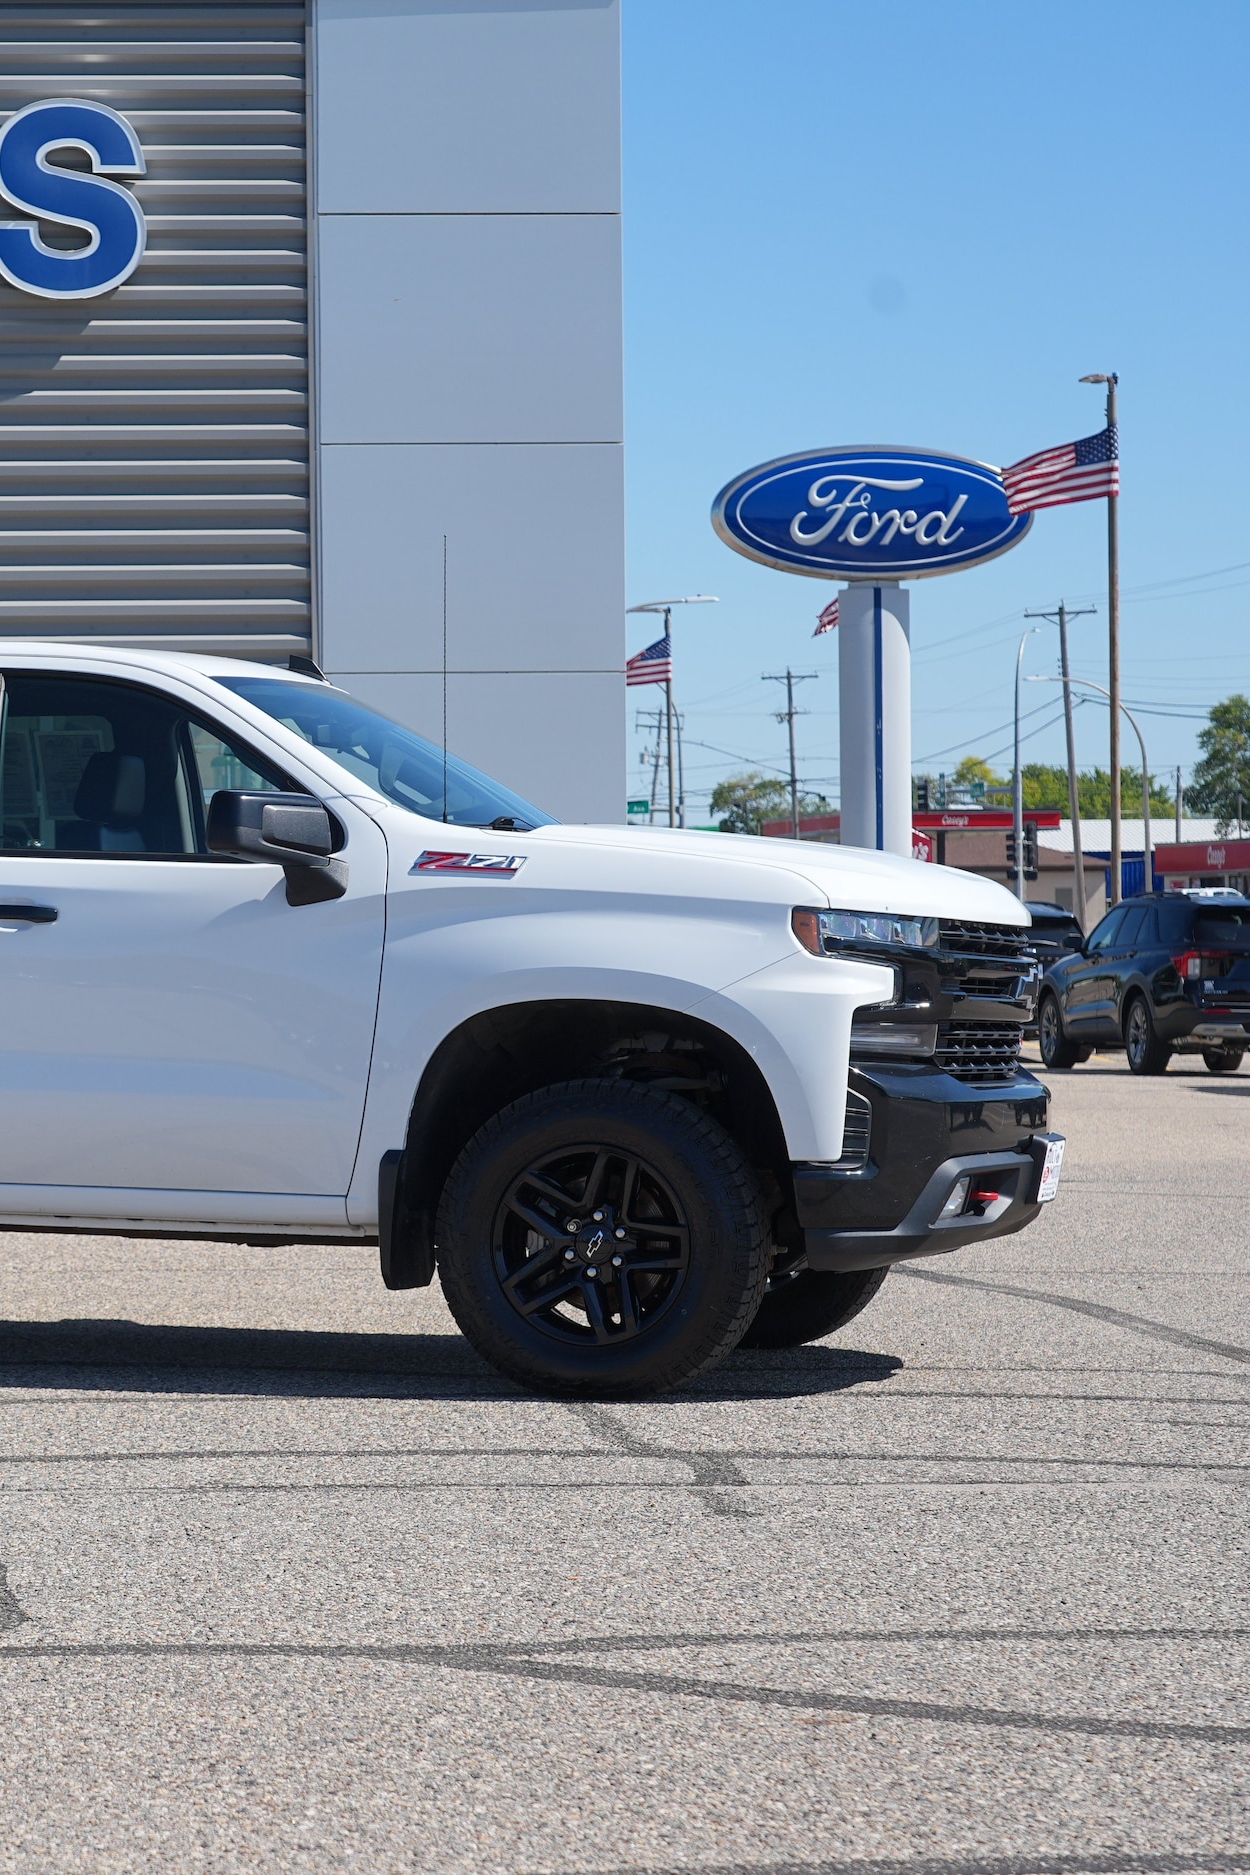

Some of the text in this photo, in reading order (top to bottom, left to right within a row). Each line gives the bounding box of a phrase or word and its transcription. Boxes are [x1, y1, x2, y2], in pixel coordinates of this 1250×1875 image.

[790, 475, 969, 546] Ford
[942, 815, 969, 827] Casey's
[417, 851, 527, 873] Z71
[1207, 845, 1226, 870] Casey's
